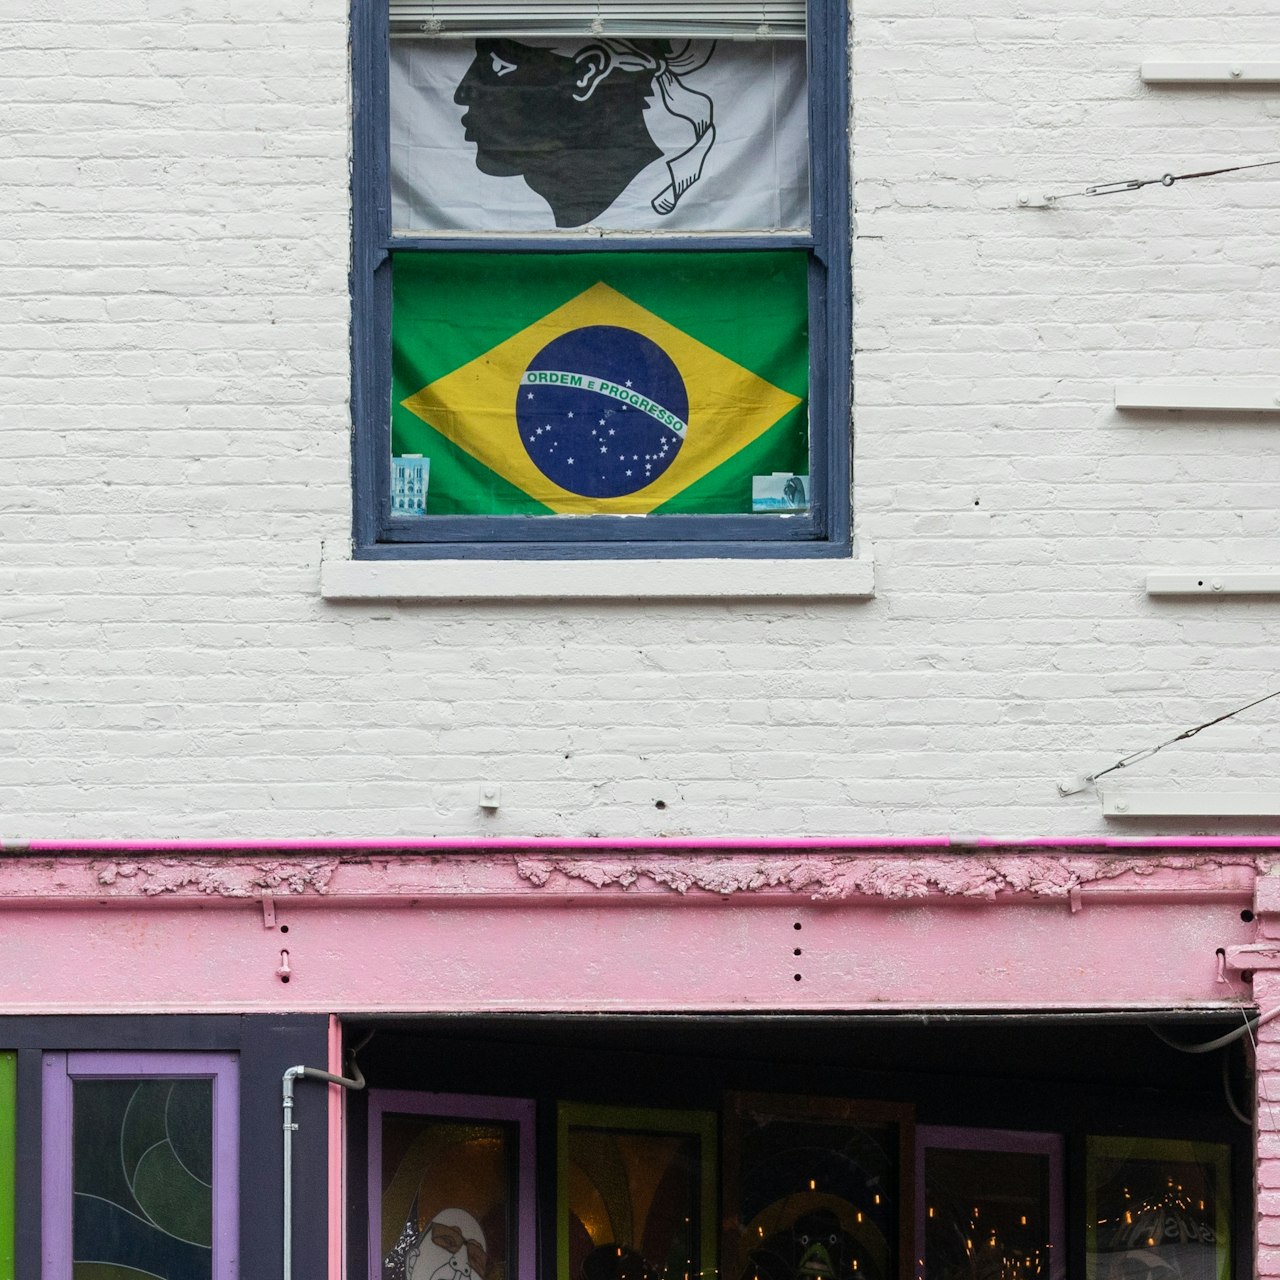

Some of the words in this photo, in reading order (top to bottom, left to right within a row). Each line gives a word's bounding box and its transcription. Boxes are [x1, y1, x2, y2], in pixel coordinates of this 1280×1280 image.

[527, 372, 583, 387] ORDEM
[588, 381, 595, 389] E
[600, 382, 684, 432] PROGRESSO
